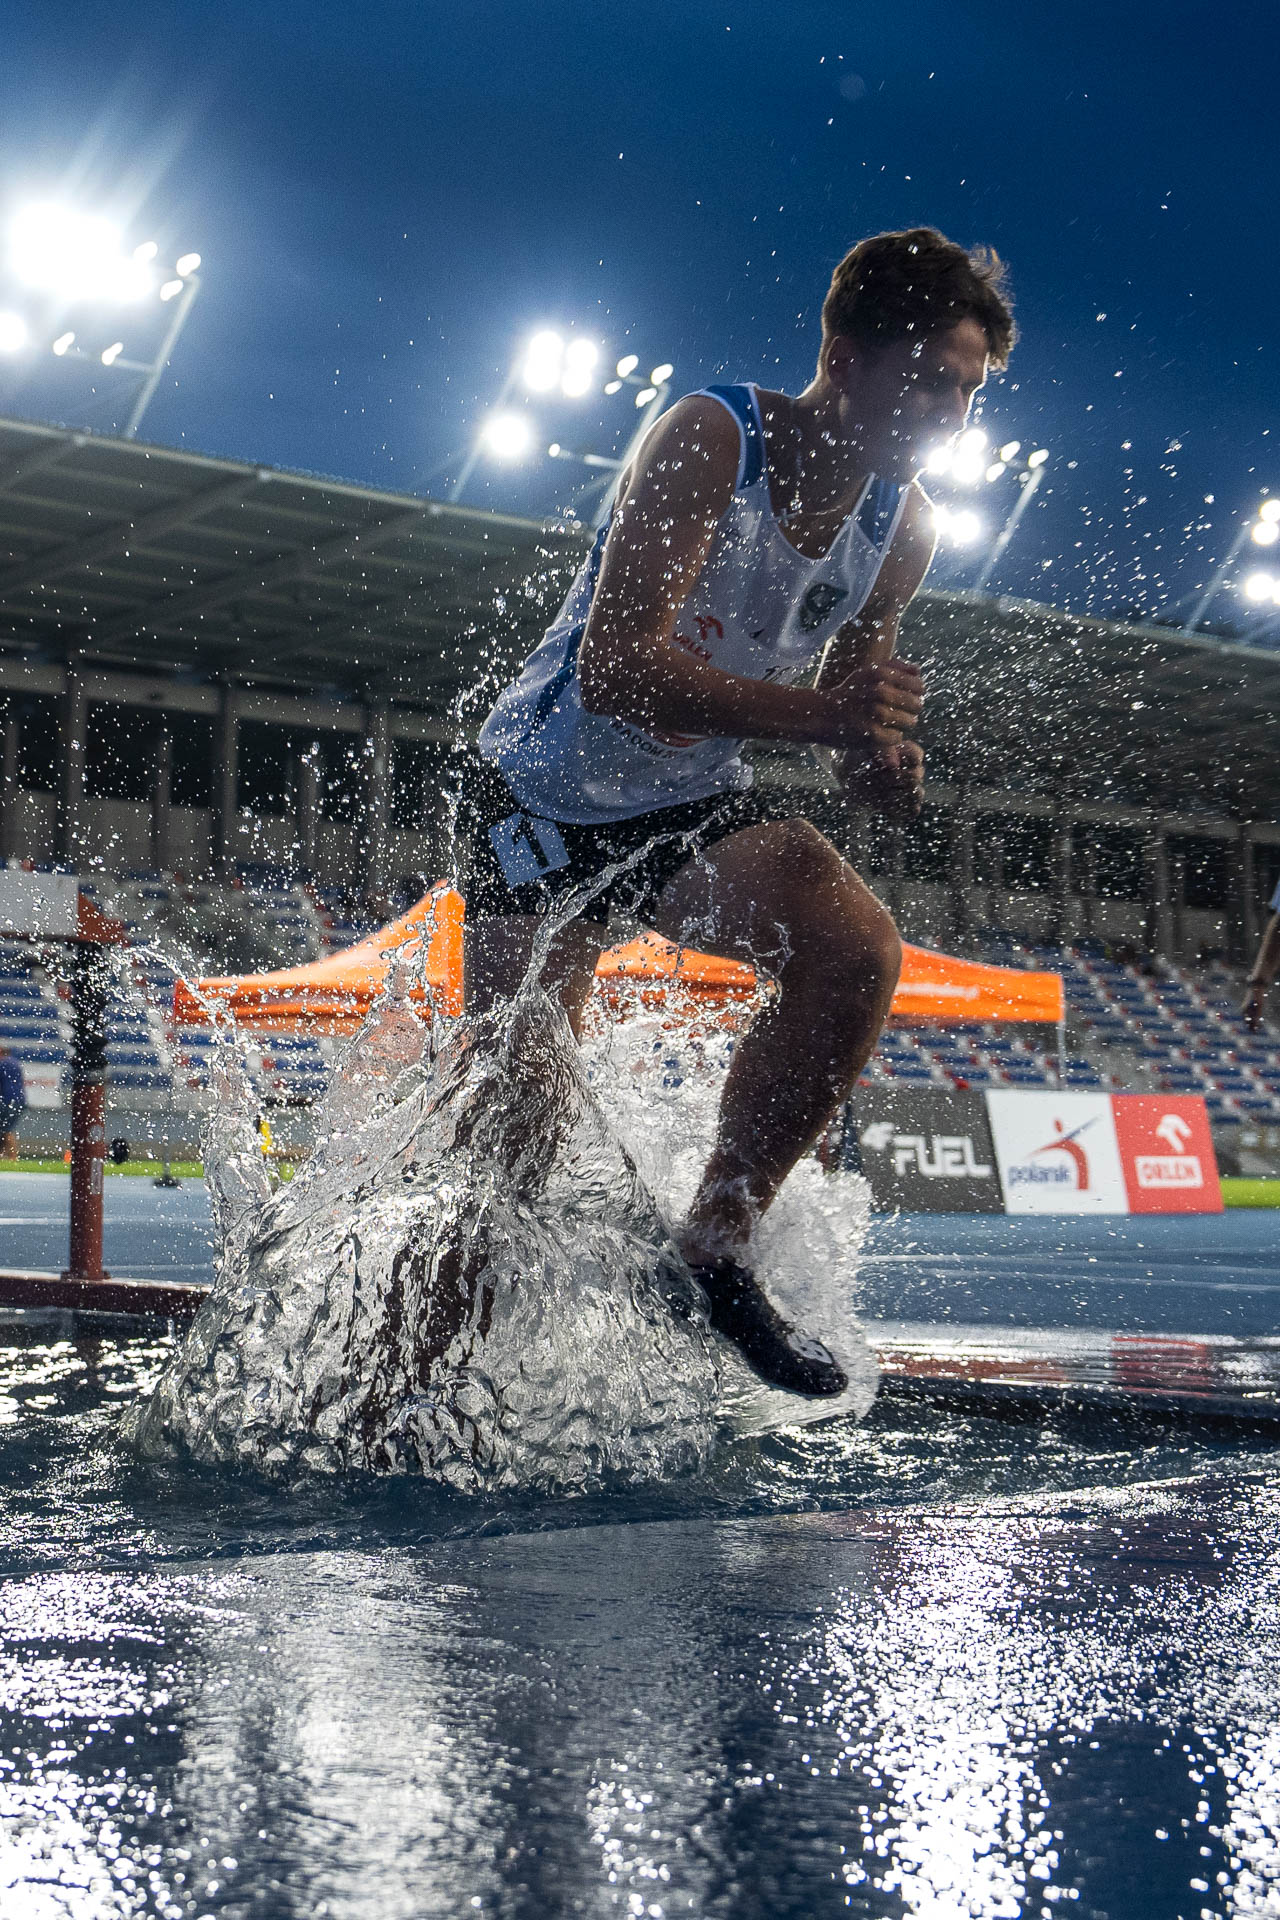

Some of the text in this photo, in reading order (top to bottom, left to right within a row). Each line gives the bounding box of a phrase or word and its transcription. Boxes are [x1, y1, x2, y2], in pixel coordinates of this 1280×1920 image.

[511, 817, 550, 870] 1
[892, 1134, 993, 1177] FUEL
[1141, 1162, 1197, 1181] ORLEN
